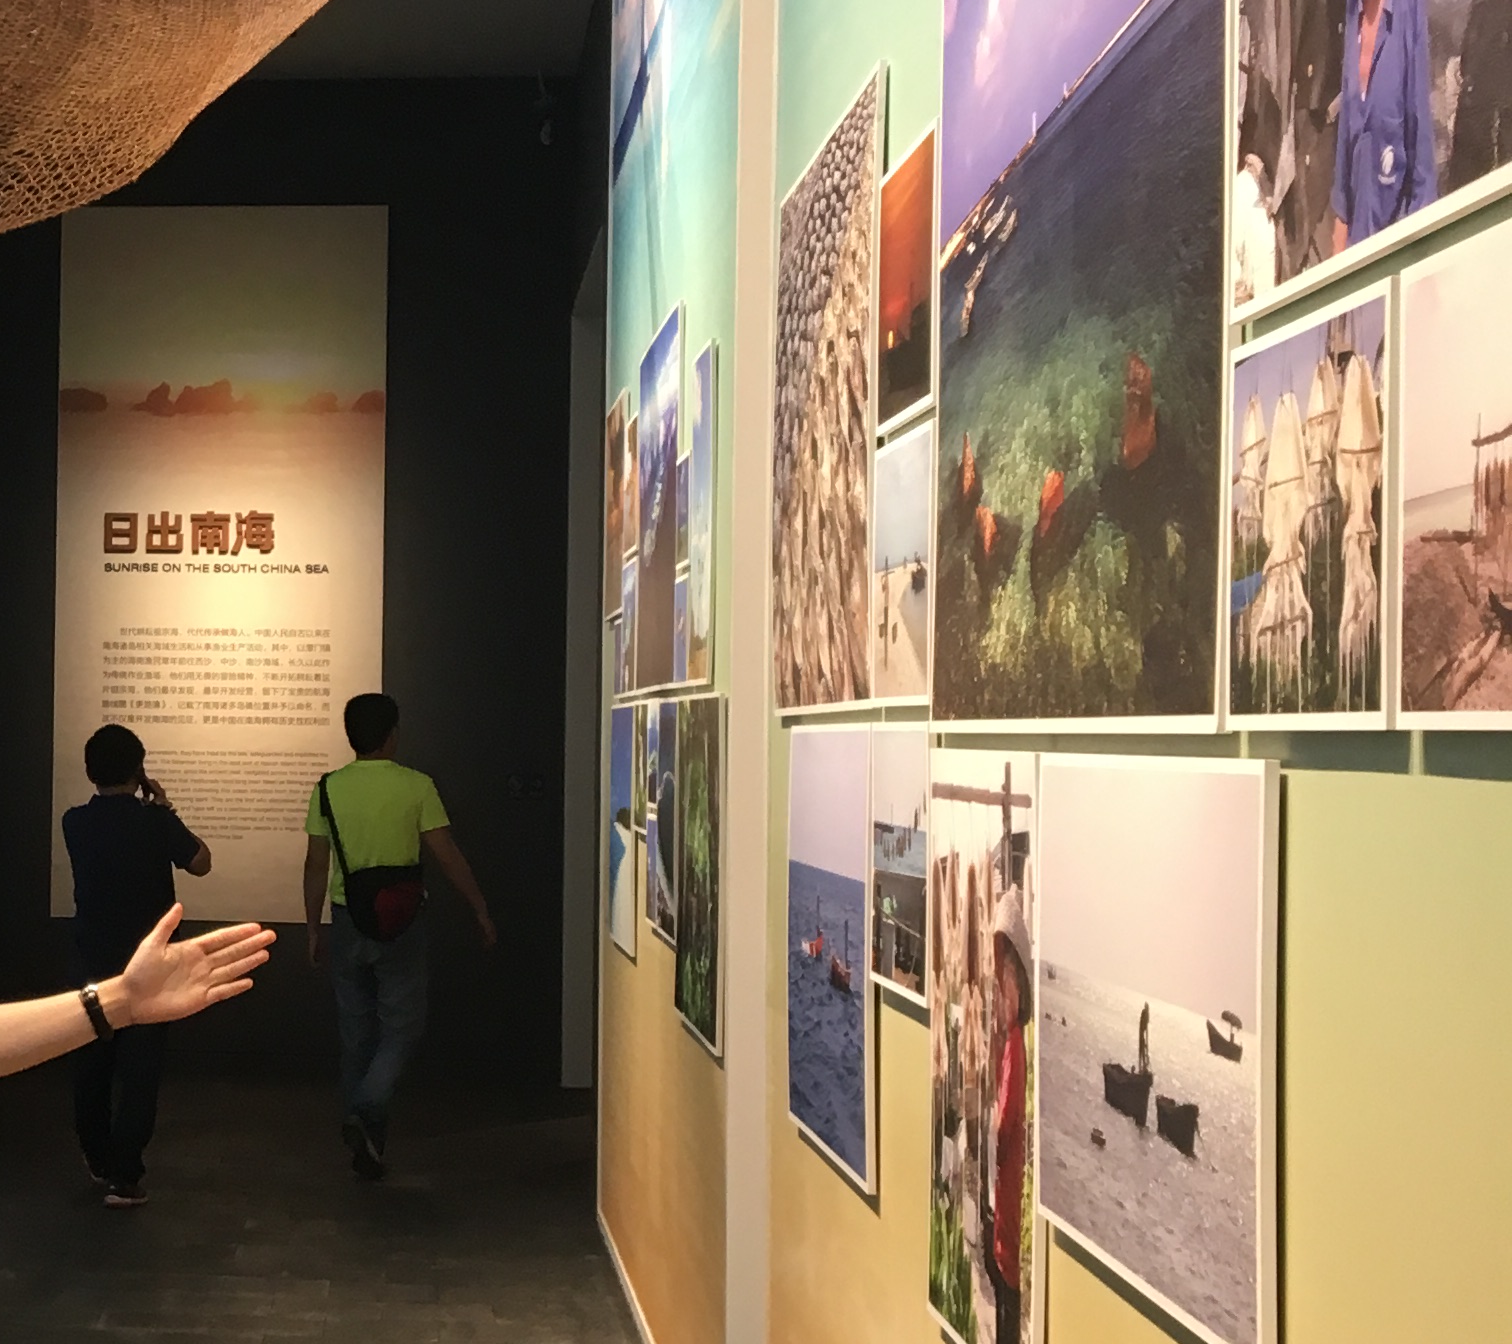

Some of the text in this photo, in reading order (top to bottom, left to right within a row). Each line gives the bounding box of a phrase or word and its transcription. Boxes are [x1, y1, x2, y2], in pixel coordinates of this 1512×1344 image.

[104, 510, 275, 556] 日出南海
[104, 562, 329, 574] SUNRISE ON THE SOUTH CHINA SEA
